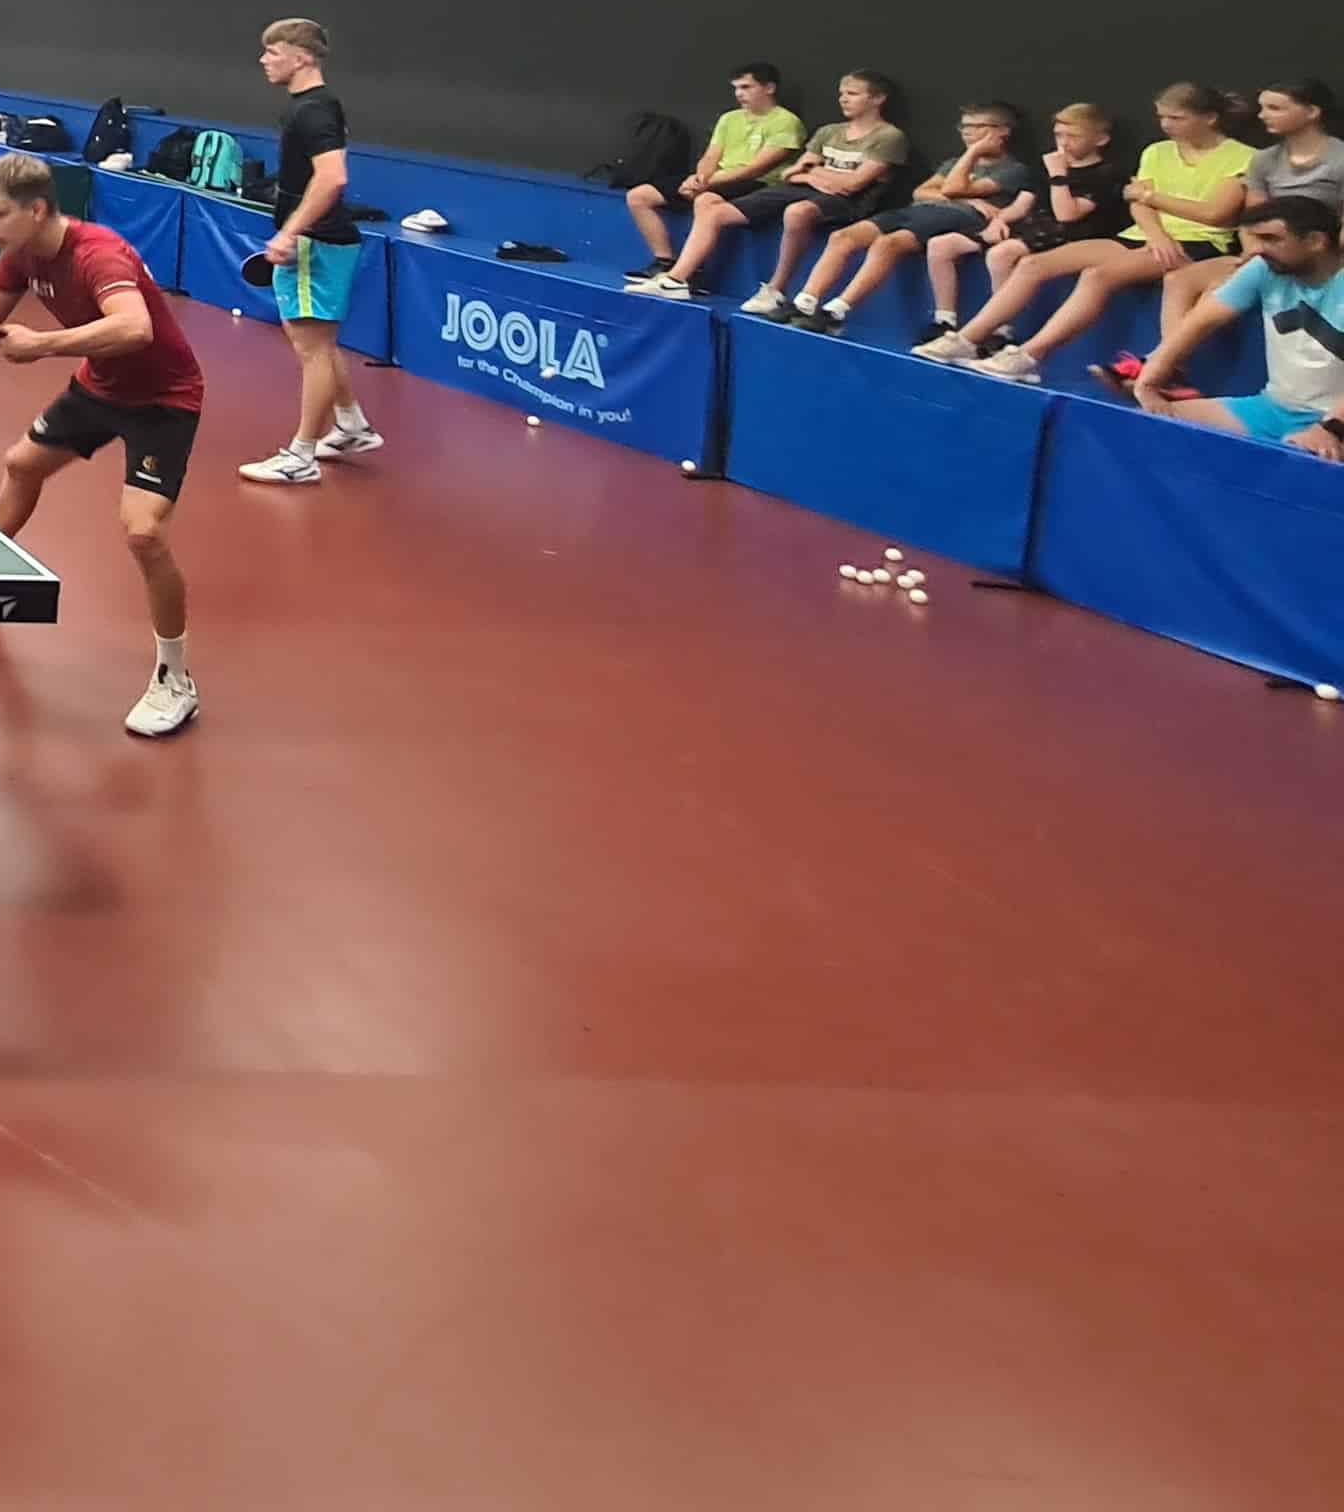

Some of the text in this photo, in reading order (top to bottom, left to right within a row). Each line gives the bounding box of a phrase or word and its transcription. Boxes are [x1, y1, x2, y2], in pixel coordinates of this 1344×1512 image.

[441, 292, 605, 388] JOOLA
[477, 359, 499, 376] the
[502, 368, 575, 413] Champion
[578, 404, 593, 419] in
